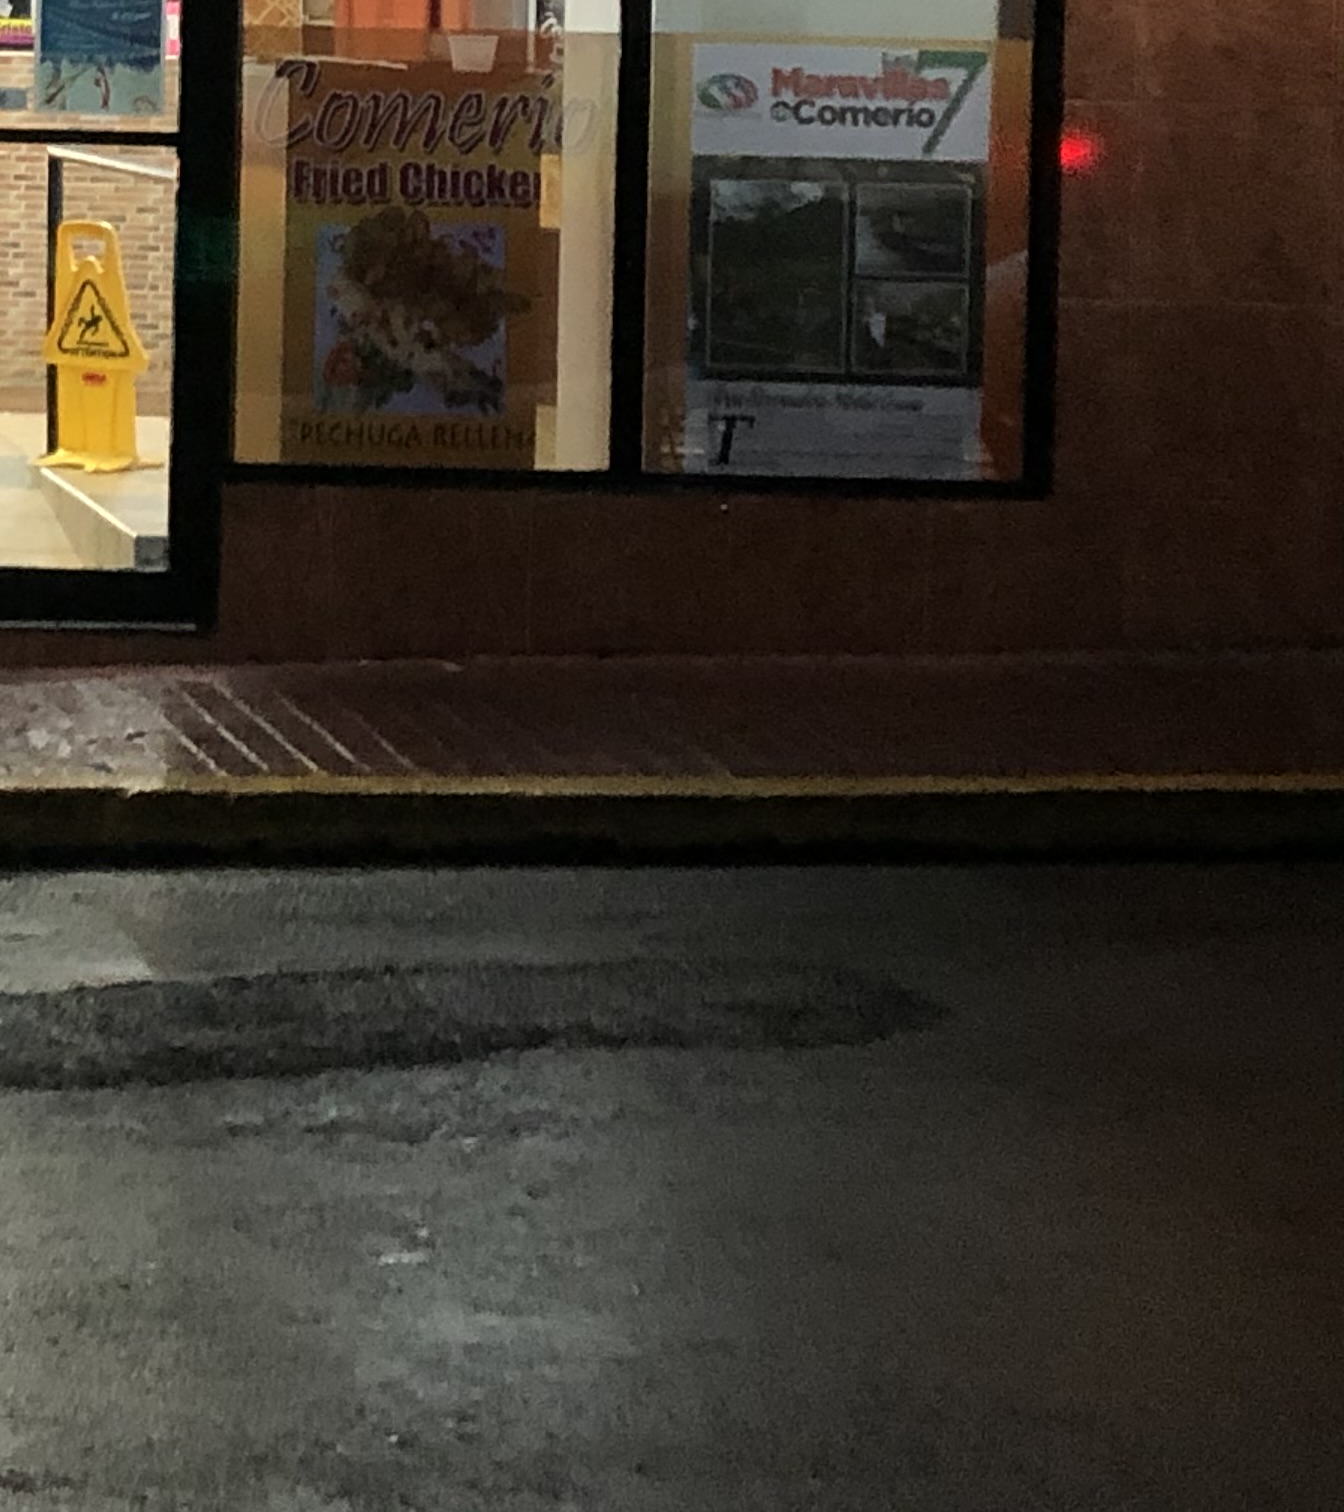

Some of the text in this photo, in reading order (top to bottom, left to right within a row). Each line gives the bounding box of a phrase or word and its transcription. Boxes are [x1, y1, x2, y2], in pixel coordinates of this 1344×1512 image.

[915, 50, 989, 156] 7
[293, 159, 540, 208] Fried Chicke
